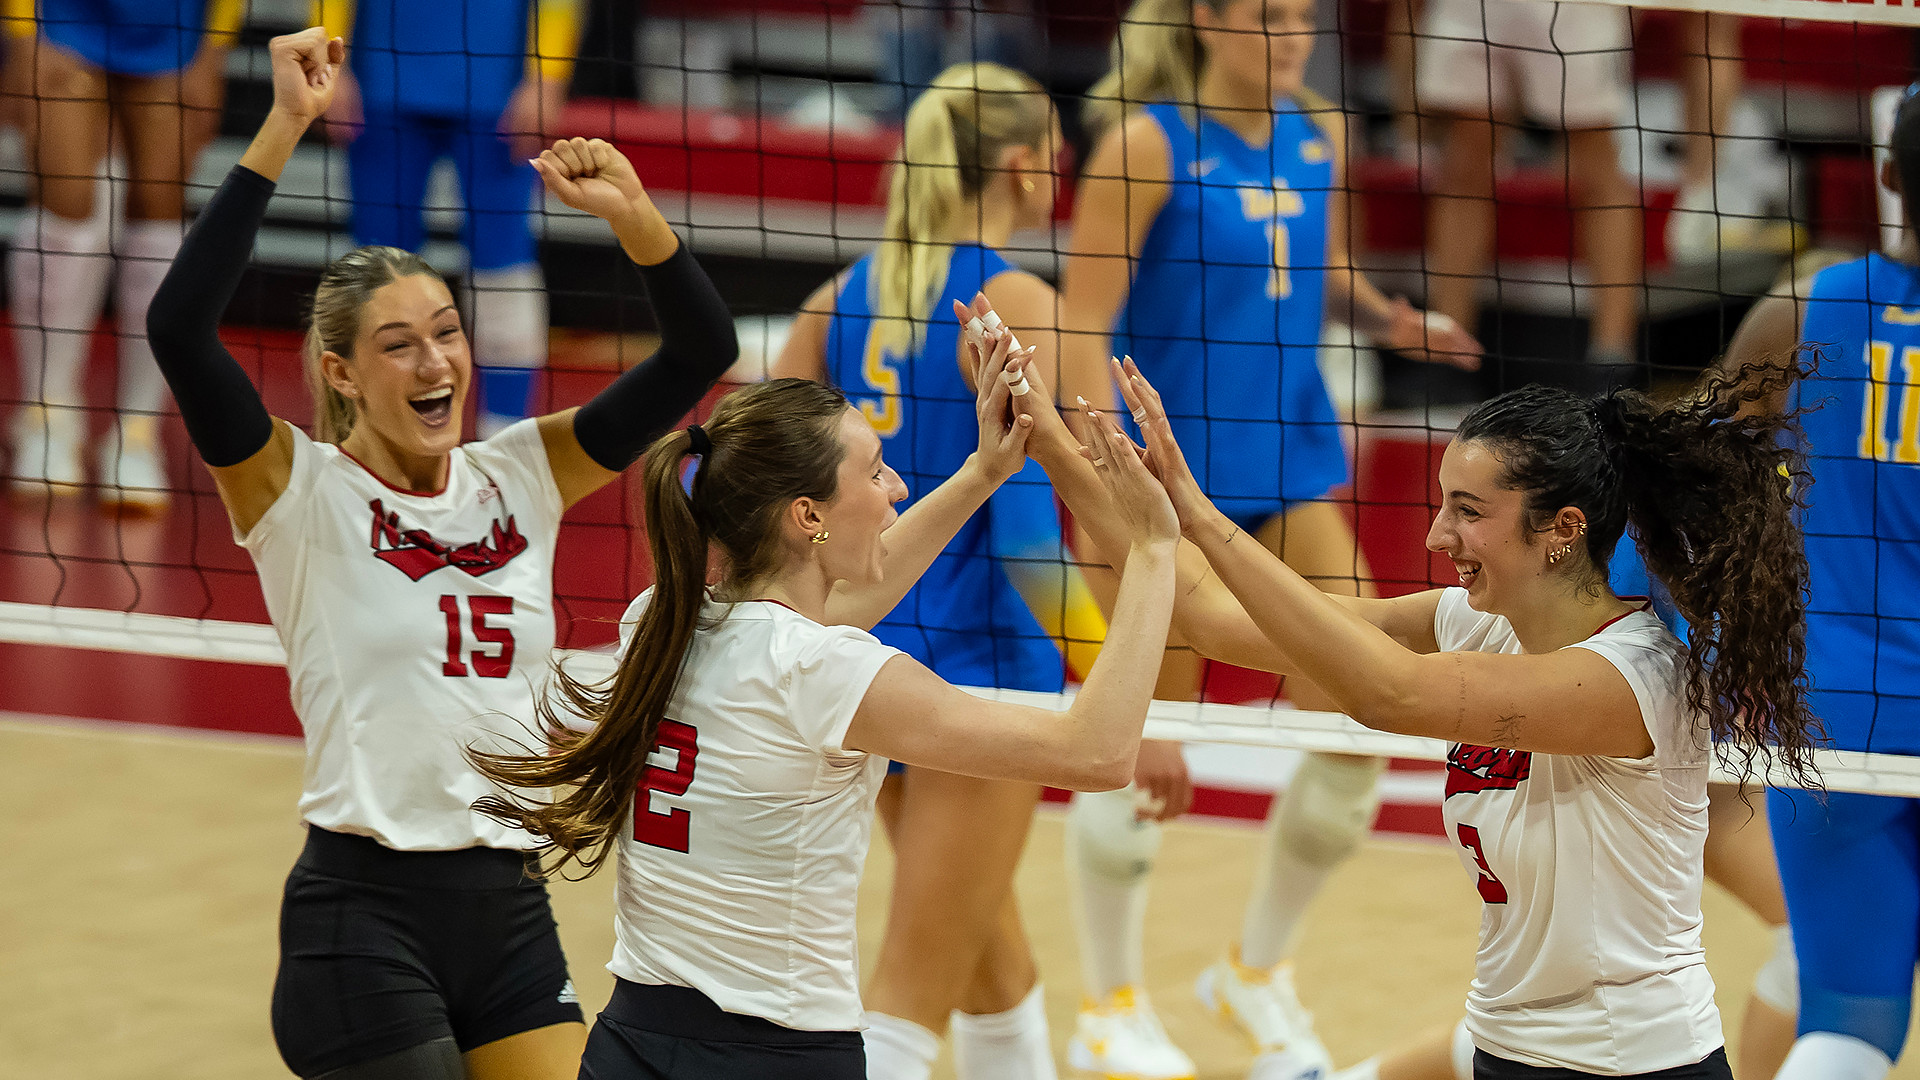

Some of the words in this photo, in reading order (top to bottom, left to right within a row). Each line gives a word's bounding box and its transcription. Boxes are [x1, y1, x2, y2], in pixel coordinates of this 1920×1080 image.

[1264, 219, 1293, 300] 1
[859, 316, 904, 438] 5
[439, 594, 515, 679] 15
[633, 717, 699, 855] 2
[1457, 822, 1508, 904] 3
